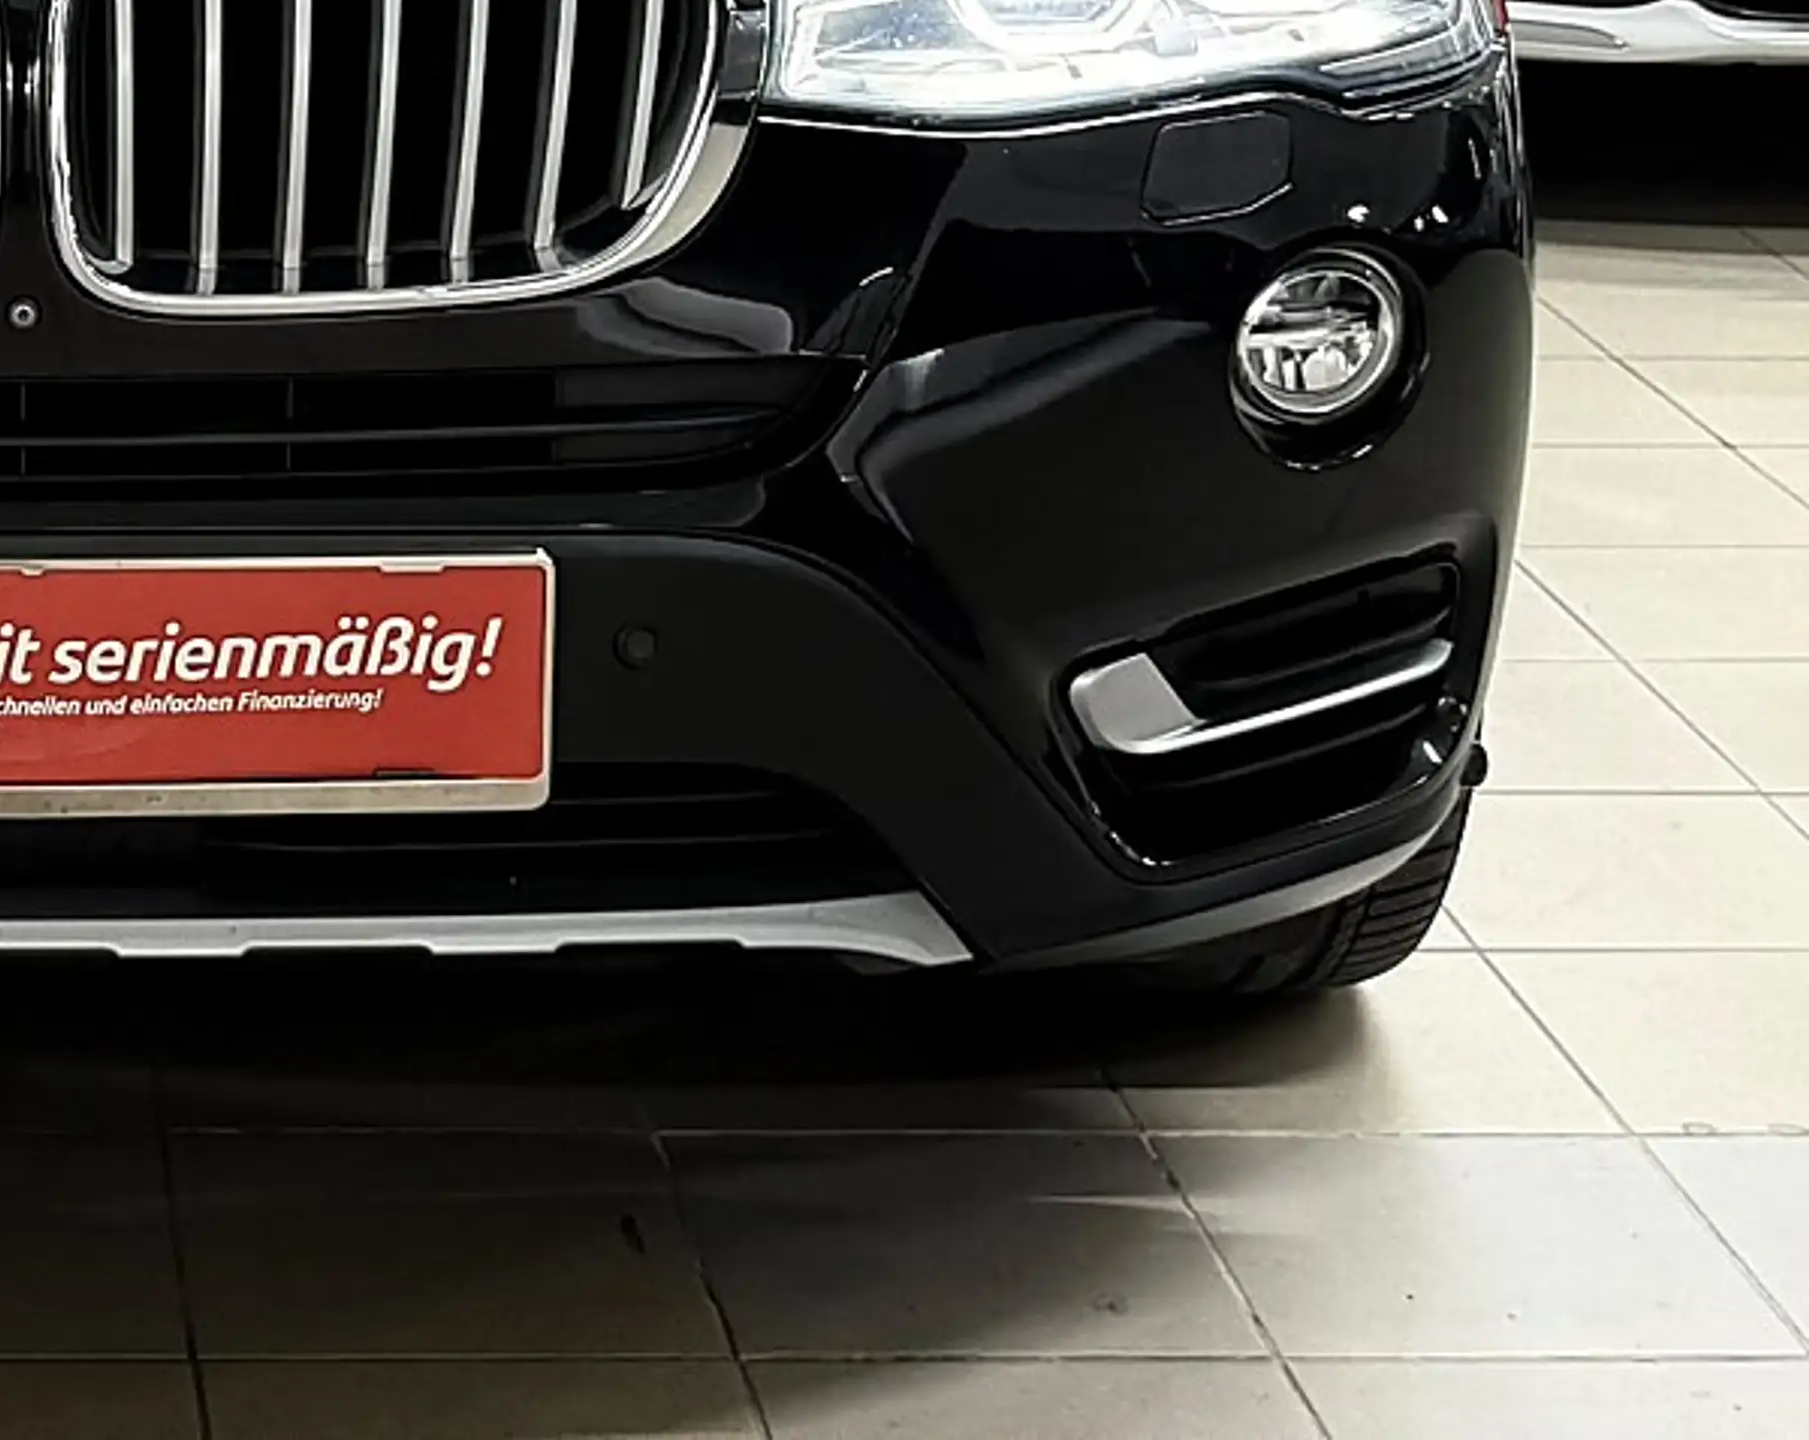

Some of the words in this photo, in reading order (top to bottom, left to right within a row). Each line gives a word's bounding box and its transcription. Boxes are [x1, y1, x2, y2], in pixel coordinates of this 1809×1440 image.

[47, 614, 503, 692] serienmäßig!
[85, 695, 128, 715] und
[129, 692, 234, 715] einfachen
[237, 688, 384, 713] Finanzierung!
